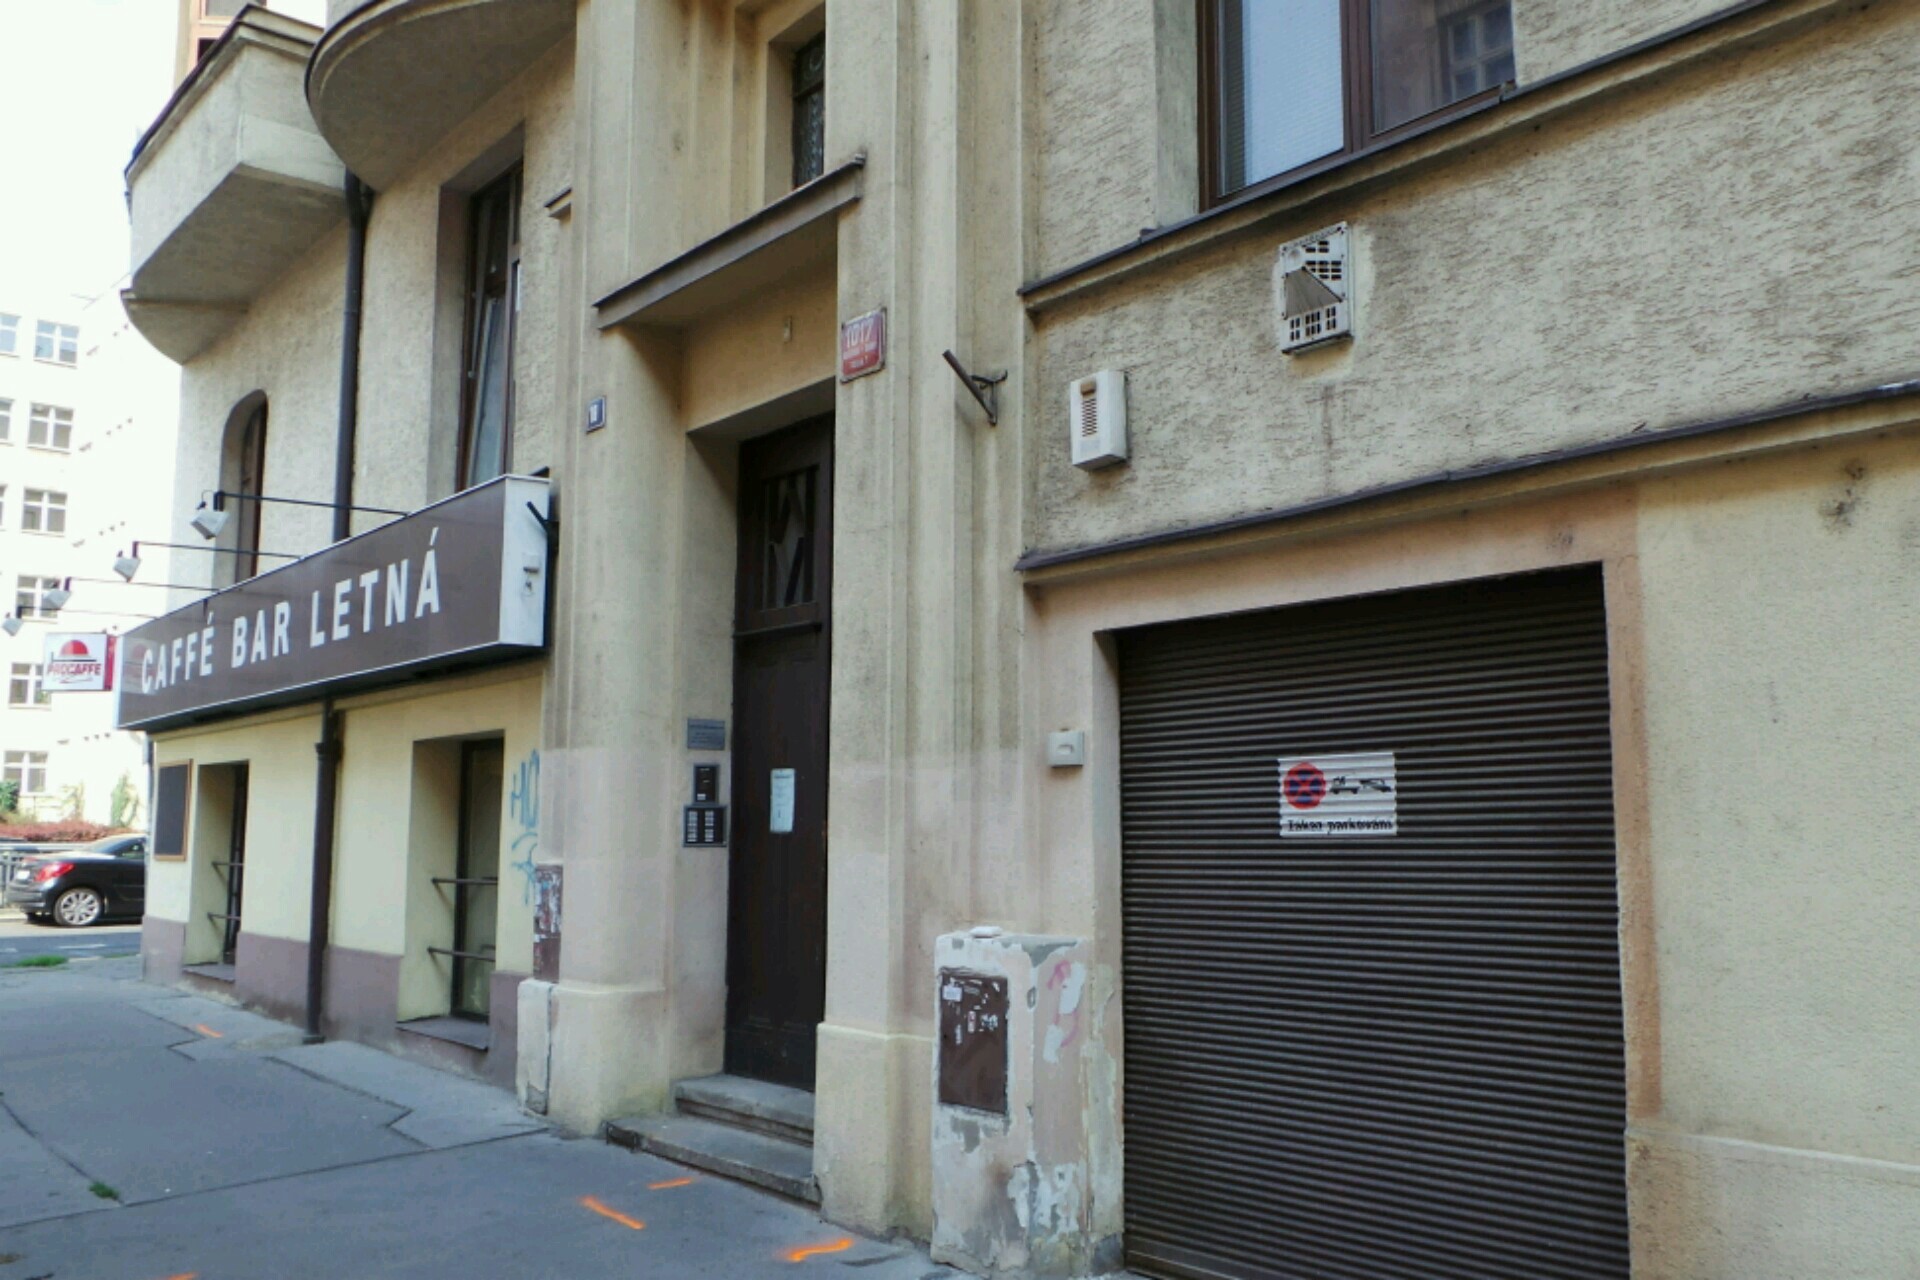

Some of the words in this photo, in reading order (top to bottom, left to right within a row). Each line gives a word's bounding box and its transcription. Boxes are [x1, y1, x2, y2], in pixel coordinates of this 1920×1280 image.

[141, 611, 215, 695] CAFFÉ
[231, 600, 292, 669] BAR
[309, 527, 440, 649] LETNÁ
